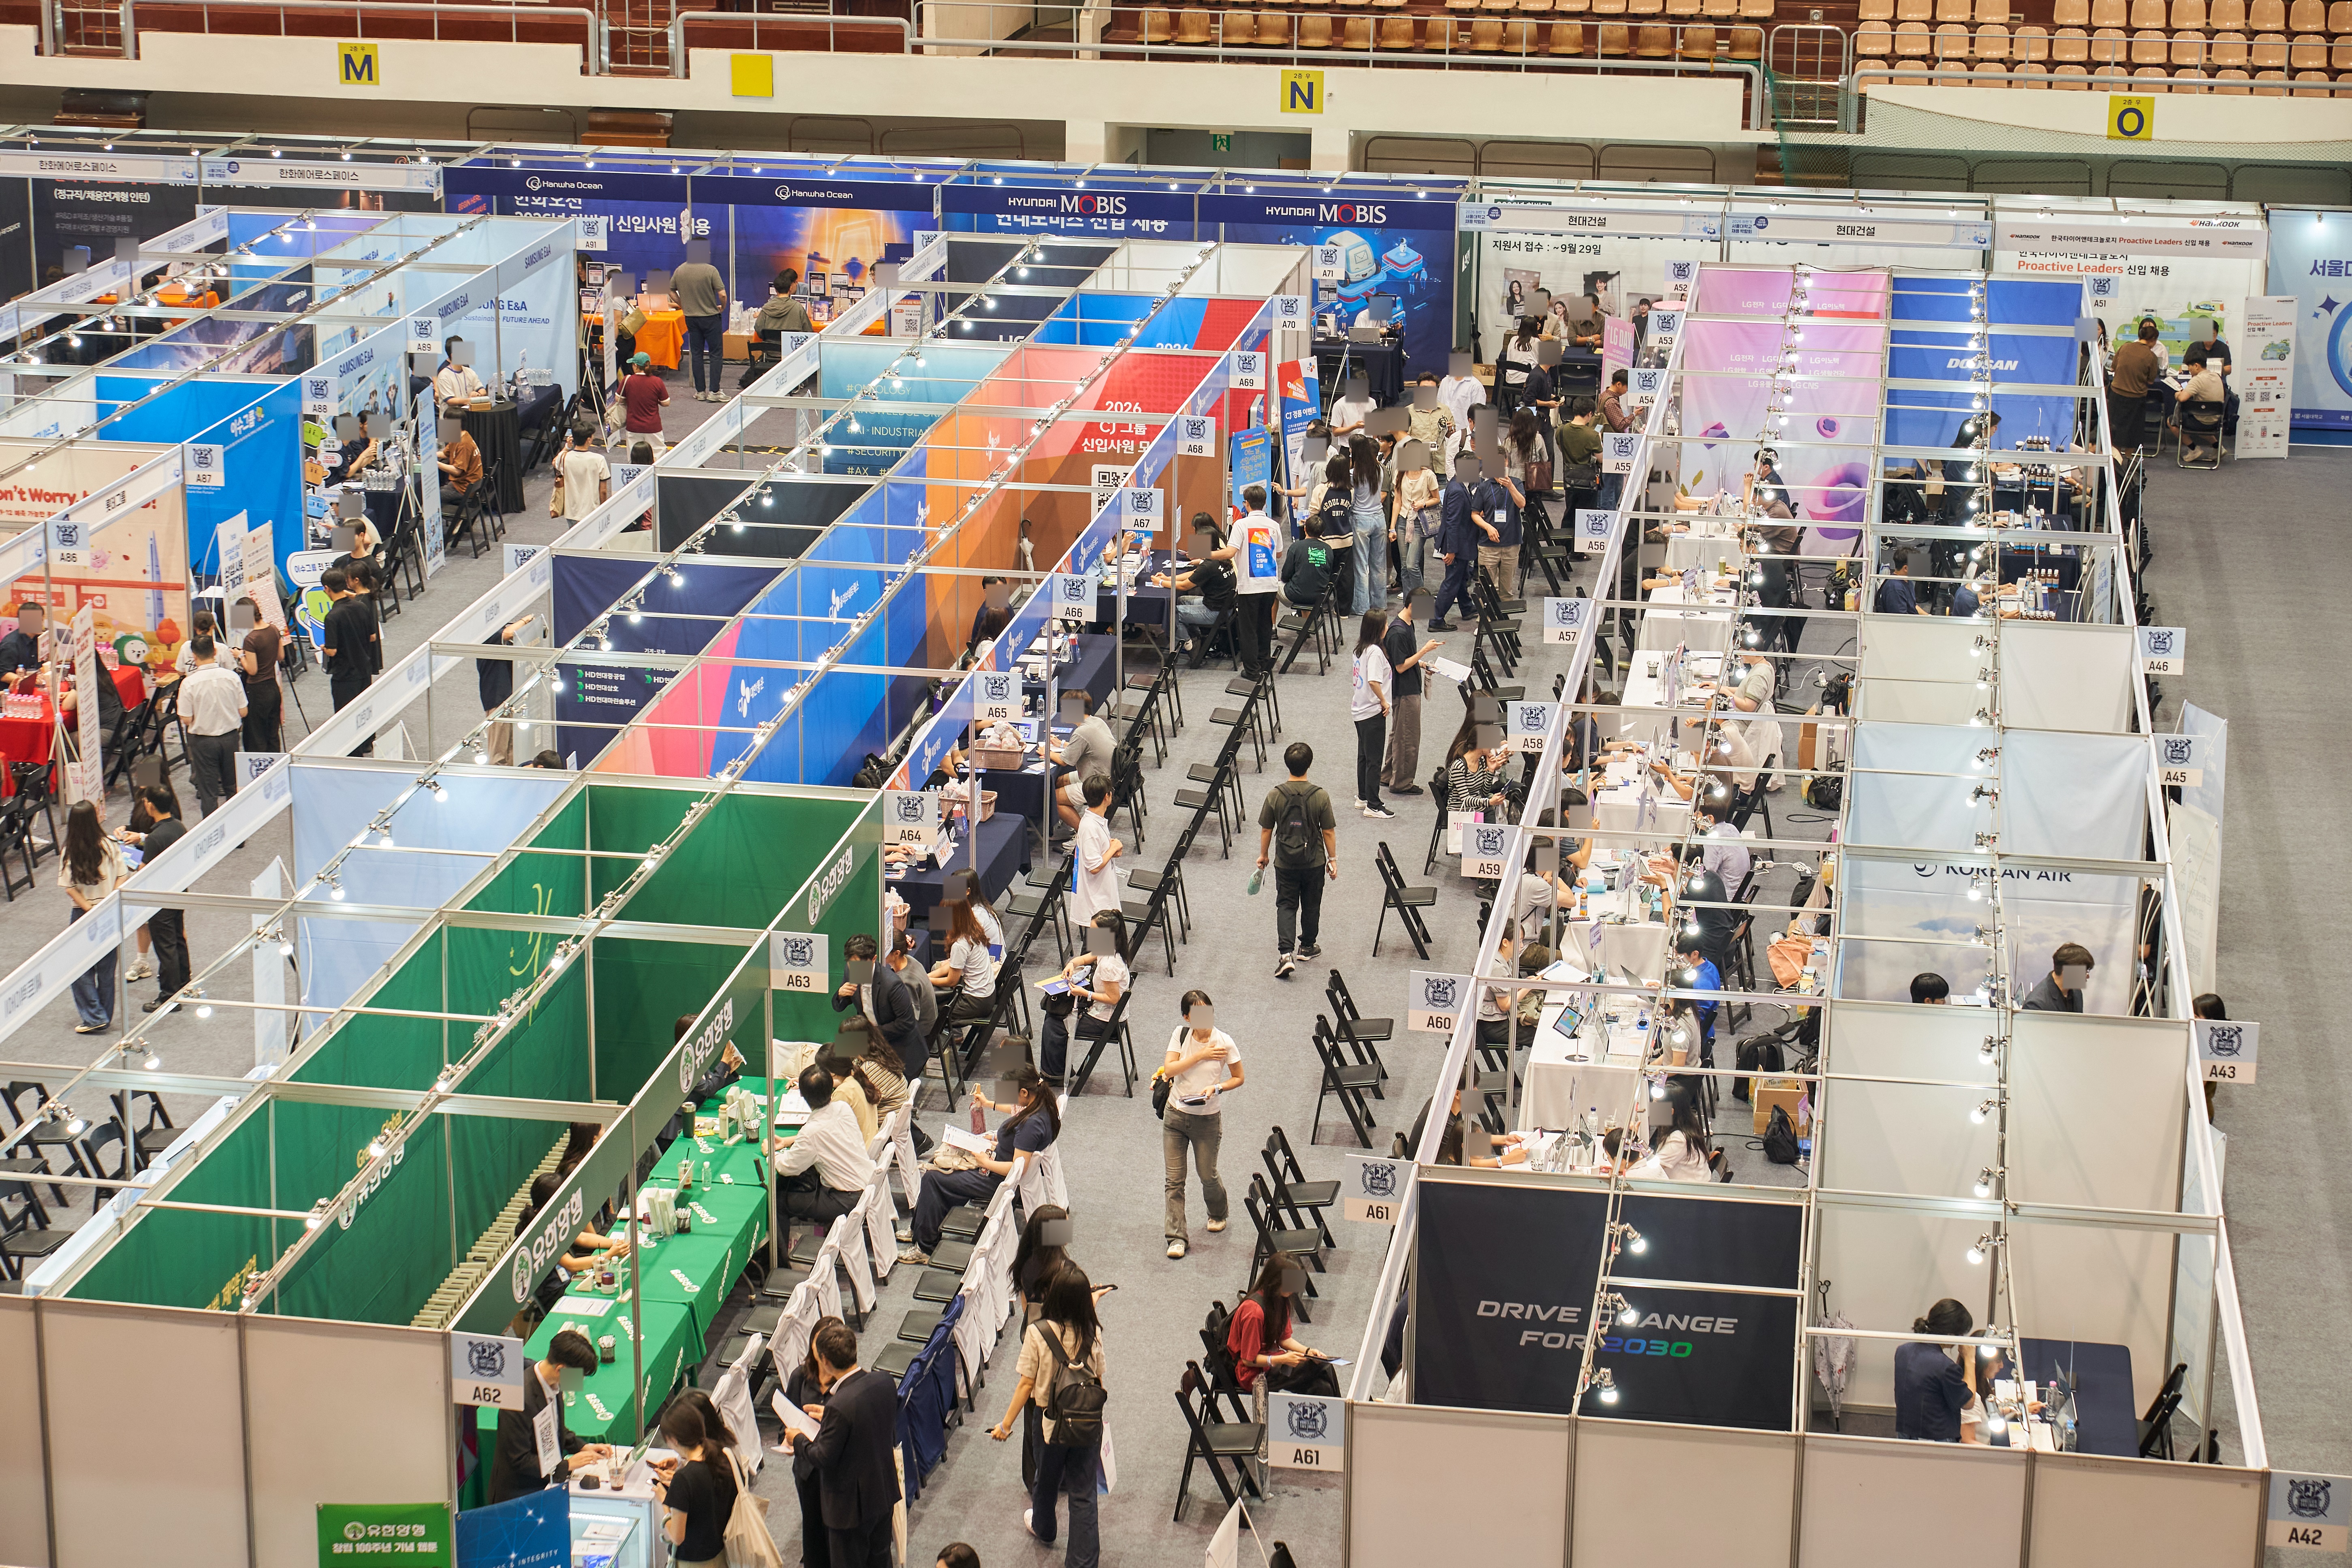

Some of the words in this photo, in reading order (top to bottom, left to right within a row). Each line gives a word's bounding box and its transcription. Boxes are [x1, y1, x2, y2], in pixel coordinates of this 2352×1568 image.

[344, 53, 373, 81] M
[1290, 81, 1314, 109] N
[2117, 107, 2144, 137] O
[39, 160, 117, 173] 한화에어로스페이스
[280, 169, 359, 181] 한화에어로스페이스
[542, 180, 575, 189] Hanwha
[577, 182, 602, 190] Ocean
[53, 188, 129, 202] (정규직/채용연계형
[130, 192, 150, 203] 인턴)
[792, 190, 825, 198] Hanwha
[827, 191, 853, 199] Ocean
[1008, 197, 1056, 208] HYUNDAI
[1060, 195, 1127, 215] MOBIS
[1266, 206, 1315, 217] HYUNDAI
[1319, 204, 1386, 224] MOBIS
[616, 216, 676, 233] 신입사원
[1568, 215, 1606, 226] 현대건설
[1836, 225, 1876, 237] 현대건설
[2051, 235, 2117, 244] 한국타이어앤테크놀로지
[1493, 240, 1521, 252] 지원서
[1524, 241, 1543, 252] 접수
[1579, 244, 1601, 255] 29일
[2017, 261, 2073, 273] Proactive
[2076, 263, 2123, 274] Leaders
[2127, 264, 2147, 275] 신입
[2149, 265, 2170, 276] 채용
[507, 300, 527, 311] E&A
[1610, 325, 1618, 346] LG
[1619, 329, 1632, 350] DAY
[339, 353, 363, 378] SAMSUNG
[364, 348, 374, 363] E&A
[1105, 401, 1142, 413] 2026
[1292, 410, 1302, 418] 경품
[1303, 406, 1317, 417] 이벤트
[1120, 424, 1147, 435] 그룹
[1081, 438, 1134, 453] 신입사원
[1188, 444, 1203, 453] A68
[846, 467, 868, 476] #AX
[1615, 462, 1630, 471] A55
[196, 474, 211, 483] A87
[1323, 498, 1339, 512] SEOUL
[1134, 519, 1150, 528] A67
[1588, 541, 1605, 550] A56
[60, 552, 77, 562] A86
[294, 563, 317, 573] 이수그룹
[829, 605, 835, 619] CJ
[839, 579, 859, 609] 올리브네트웍스
[1065, 607, 1083, 617] A66
[1559, 632, 1576, 641] A57
[2149, 661, 2168, 671] A46
[585, 670, 625, 681] HD현대중공업
[585, 683, 619, 692] HD현대삼호
[585, 695, 636, 706] HD현대마린솔루션
[737, 696, 745, 713] CJ
[750, 677, 765, 700] 대한통운
[987, 707, 1007, 718] A65
[1523, 739, 1542, 748] A58
[2165, 772, 2186, 783] A45
[1457, 822, 1462, 830] LG
[899, 831, 921, 842] A64
[821, 844, 853, 906] 유한양행
[1478, 864, 1500, 875] A59
[1946, 866, 2029, 879] KOREAN
[2036, 869, 2072, 883] AIR
[787, 976, 810, 988] A63
[1427, 1017, 1451, 1029] A60
[694, 997, 734, 1068] 유한양행
[2209, 1066, 2236, 1079] A43
[1367, 1206, 1389, 1220] A61
[532, 1187, 584, 1273] 유한양행
[1477, 1300, 1581, 1324] DRIVE
[1519, 1330, 1587, 1350] FOR
[1601, 1336, 1693, 1358] 2030
[473, 1388, 501, 1403] A62
[1293, 1449, 1319, 1465] A61
[367, 1524, 425, 1537] 유한양행
[2288, 1528, 2323, 1546] A42
[332, 1542, 353, 1554] 창립
[355, 1541, 393, 1554] 100주년
[395, 1541, 414, 1553] 기념
[417, 1541, 438, 1553] 웹툰
[518, 1549, 558, 1566] INTEGRITY
